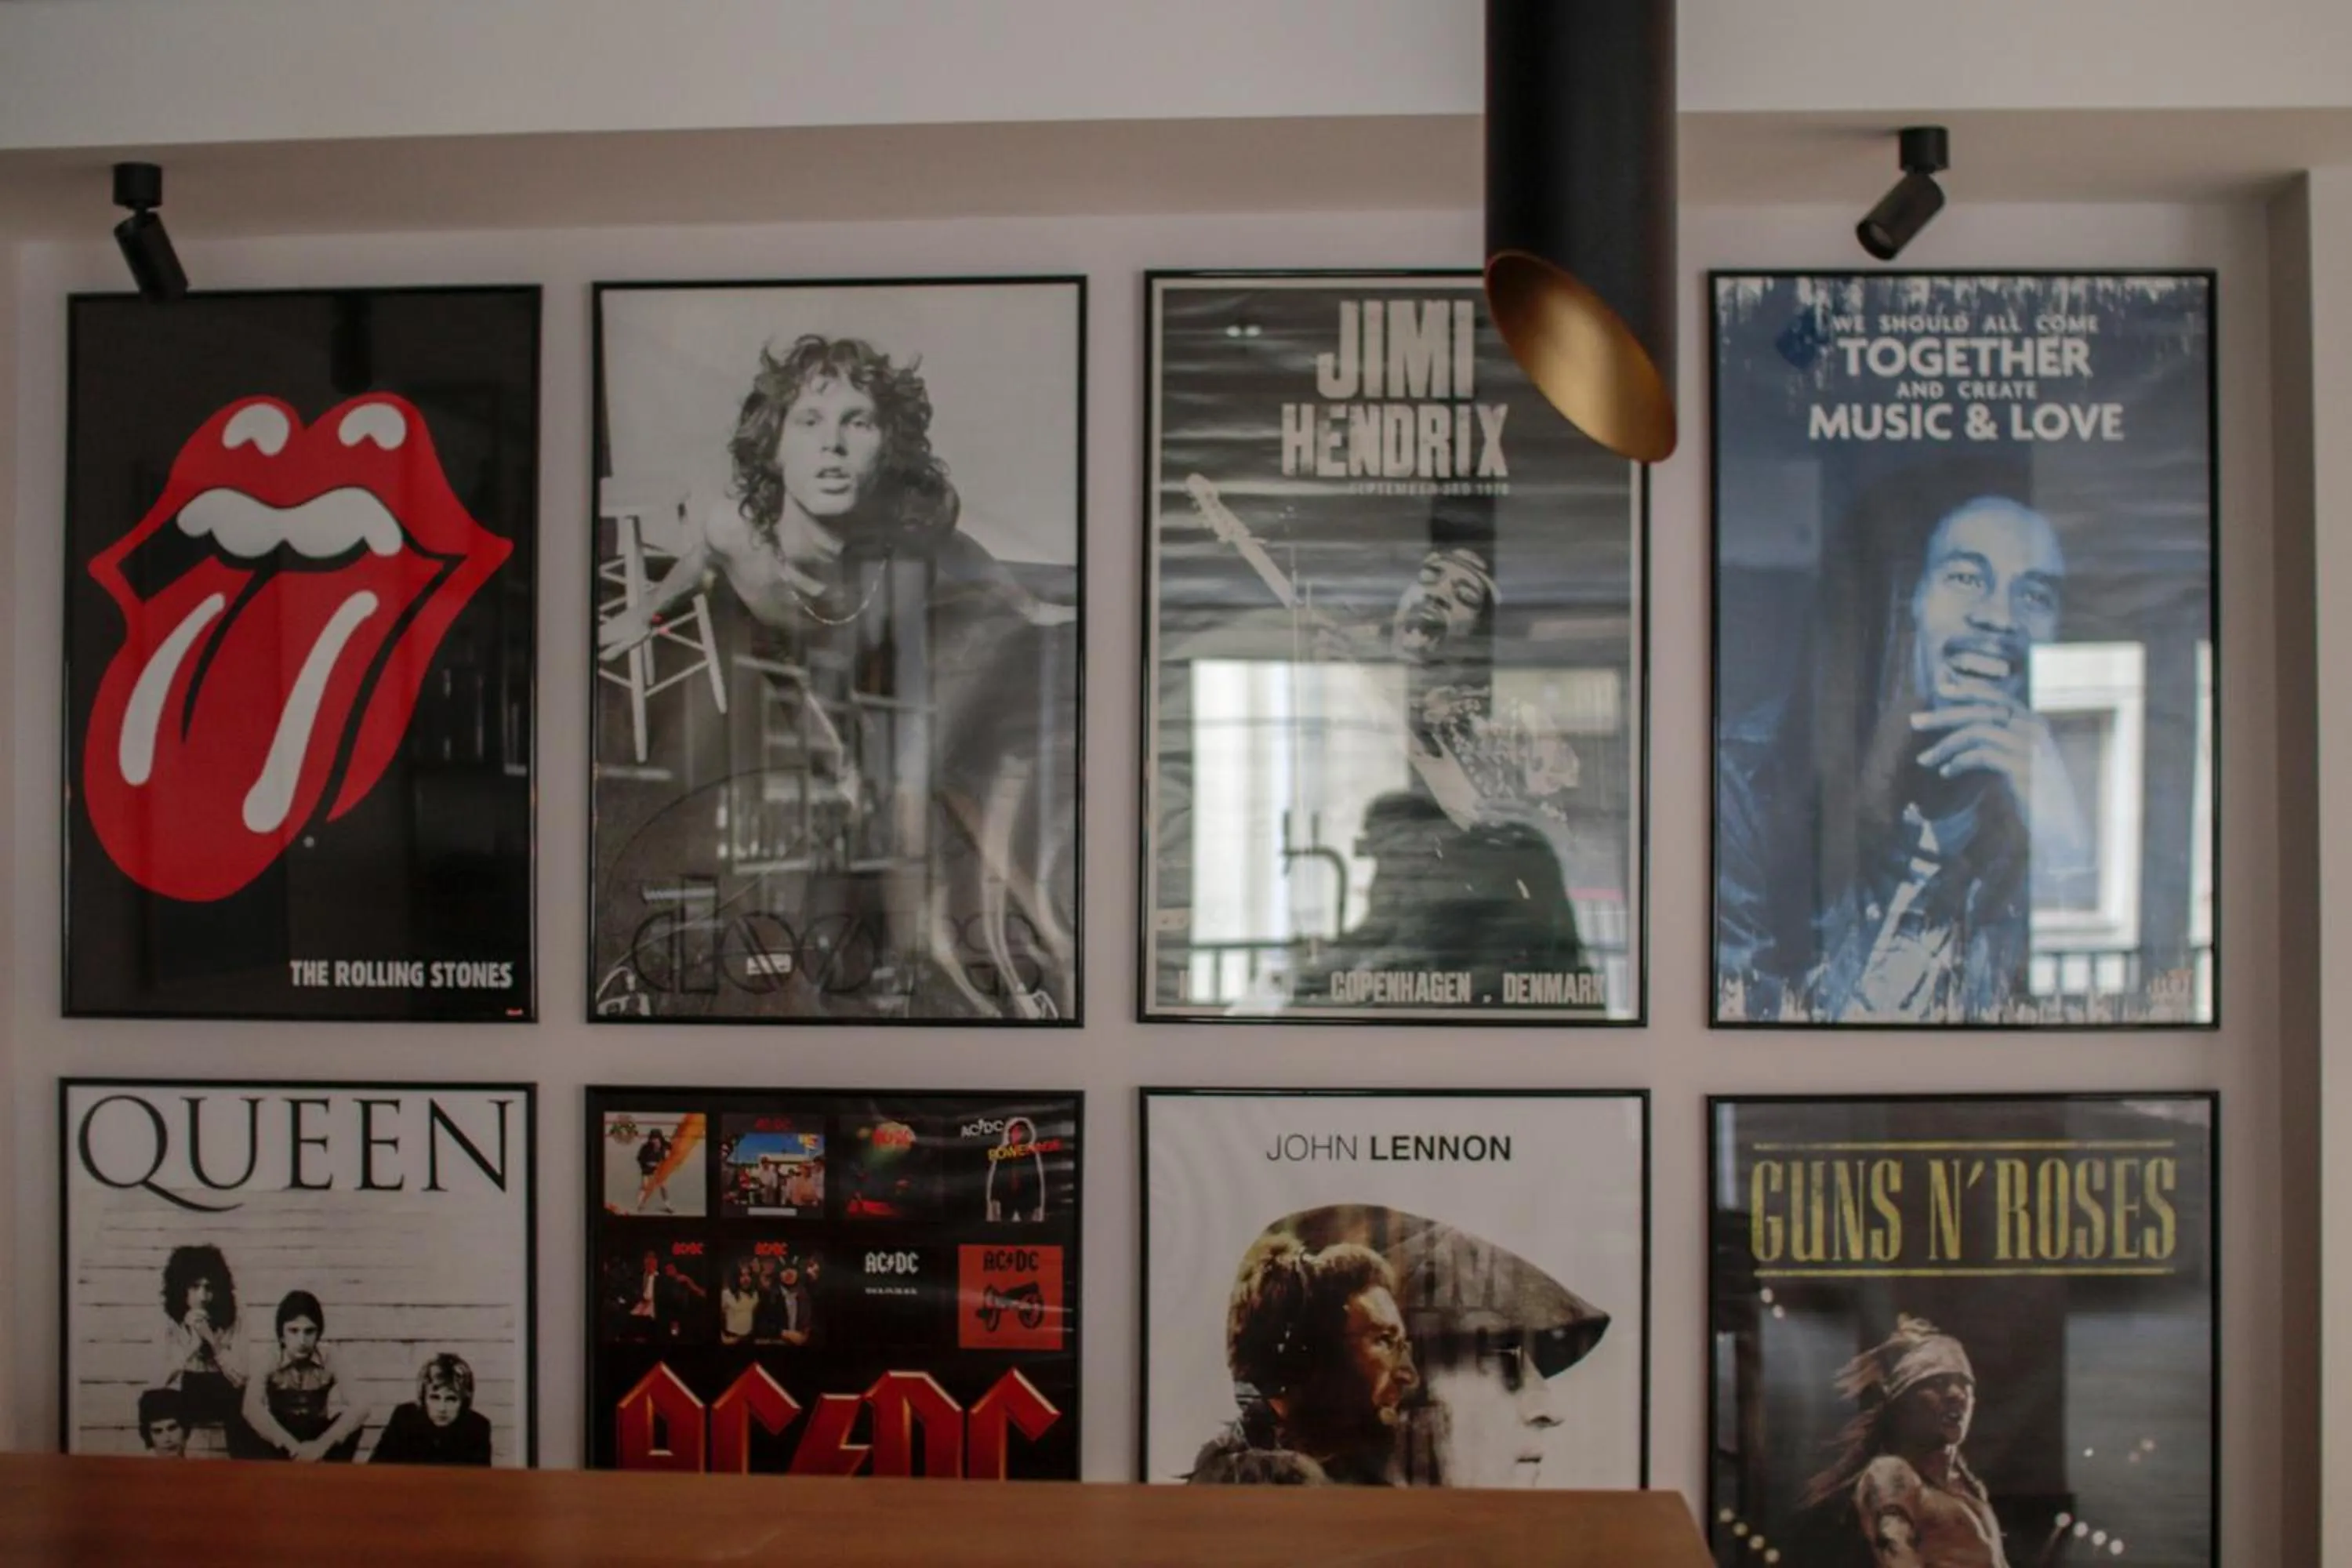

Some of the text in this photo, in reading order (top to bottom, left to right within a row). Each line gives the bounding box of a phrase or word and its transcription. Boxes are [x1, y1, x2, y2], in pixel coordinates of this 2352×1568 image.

[1833, 314, 2099, 333] WE SHOULD ALL COME
[1316, 300, 1475, 398] JIMI
[1837, 337, 2093, 377] TOGETHER
[1895, 381, 2037, 399] AND CREATE
[1281, 403, 1509, 477] HENDRIX
[1809, 403, 2125, 441] MUSIC & LOVE
[290, 960, 514, 989] THE ROLLING STONES
[1331, 971, 1471, 1004] COPENHAGEN
[1503, 972, 1605, 1005] DENMARK
[78, 1094, 515, 1213] QUEEN
[1266, 1134, 1512, 1162] JOHN LENNON
[1751, 1159, 1903, 1263] GUNS
[1994, 1156, 2177, 1261] ROSES
